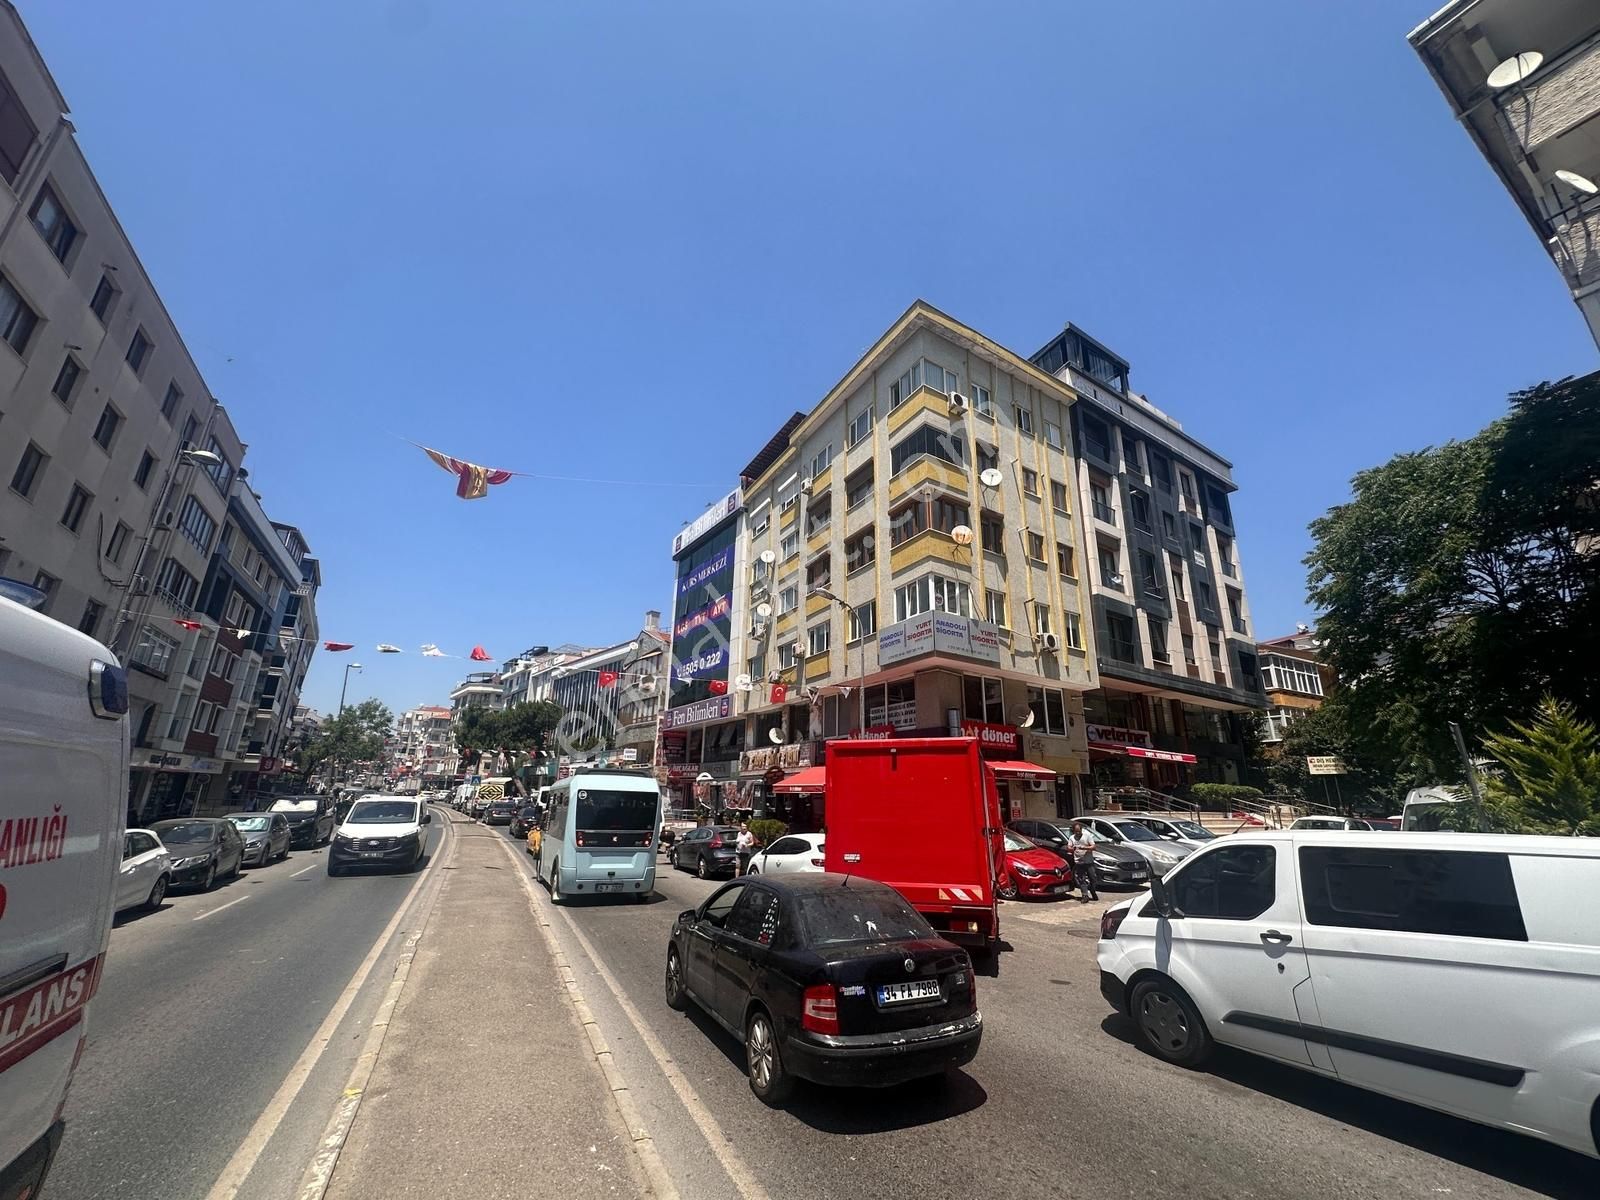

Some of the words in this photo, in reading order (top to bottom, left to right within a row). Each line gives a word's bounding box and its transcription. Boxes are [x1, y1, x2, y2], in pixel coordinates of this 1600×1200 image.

[698, 554, 728, 581] MERKEZİ
[712, 599, 728, 618] AYT
[915, 619, 932, 631] YURT
[936, 619, 967, 631] ANADOLU
[936, 626, 964, 639] SİGORTA
[879, 630, 904, 644] ANADOLU
[907, 627, 932, 641] SİGORTA
[971, 634, 999, 646] SİGORTA
[980, 629, 998, 639] YURT
[706, 651, 722, 668] 222
[672, 711, 686, 727] Fen
[686, 700, 719, 723] Bilimleri
[982, 727, 1016, 743] döner
[1095, 727, 1148, 744] veteriner
[0, 803, 68, 869] ANLIĞI
[884, 986, 897, 1001] 34
[900, 984, 913, 999] FA
[916, 981, 938, 997] 7988
[0, 968, 86, 1048] LANS
